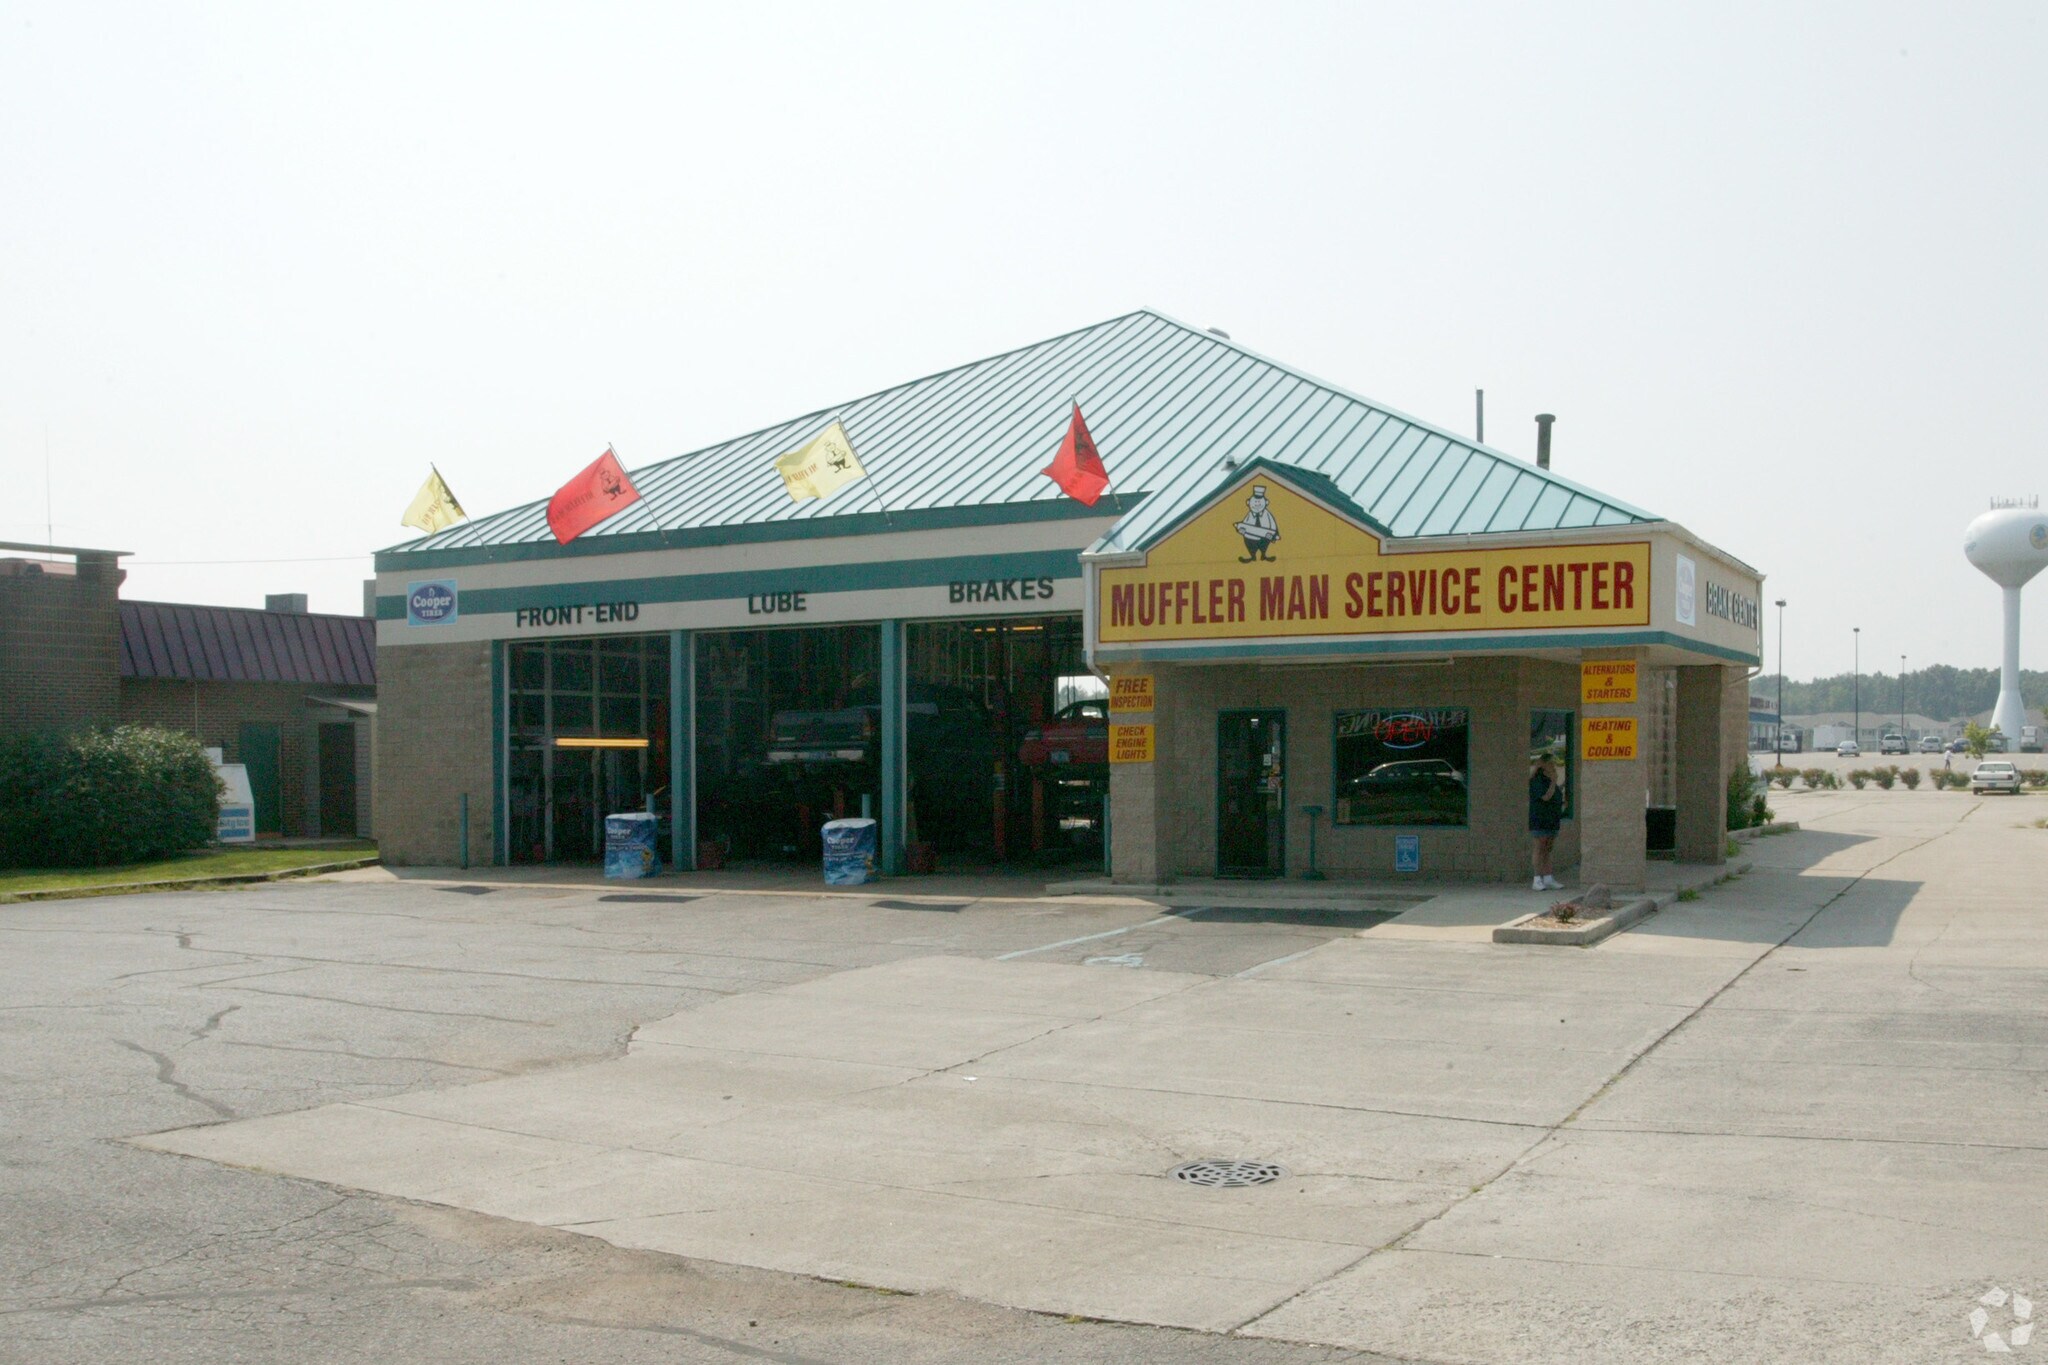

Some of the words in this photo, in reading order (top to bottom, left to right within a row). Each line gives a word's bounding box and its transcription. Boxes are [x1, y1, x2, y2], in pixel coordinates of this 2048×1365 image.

[949, 576, 1054, 604] BRAKES
[1111, 578, 1245, 627] MUFFLER
[1260, 574, 1329, 621] MAN
[1345, 566, 1482, 619] SERVICE
[1498, 561, 1634, 614] CENTER
[412, 595, 452, 609] Cooper
[747, 590, 807, 616] LUBE
[1706, 581, 1733, 621] BRAKE
[421, 609, 443, 618] TIRES
[516, 601, 639, 628] FRONT-END
[1583, 664, 1636, 675] ALTERNATORS
[1115, 678, 1149, 693] FREE
[1605, 677, 1613, 687] &
[1586, 688, 1632, 699] STARTERS
[1111, 695, 1153, 708] INSPECTION
[1117, 726, 1146, 737] CHECK
[1375, 719, 1433, 742] OPEN
[1588, 720, 1632, 731] HEATING
[1116, 737, 1147, 748] ENGINE
[1605, 733, 1613, 744] &
[1116, 748, 1147, 760] LIGHTS
[1588, 746, 1632, 757] COOLING
